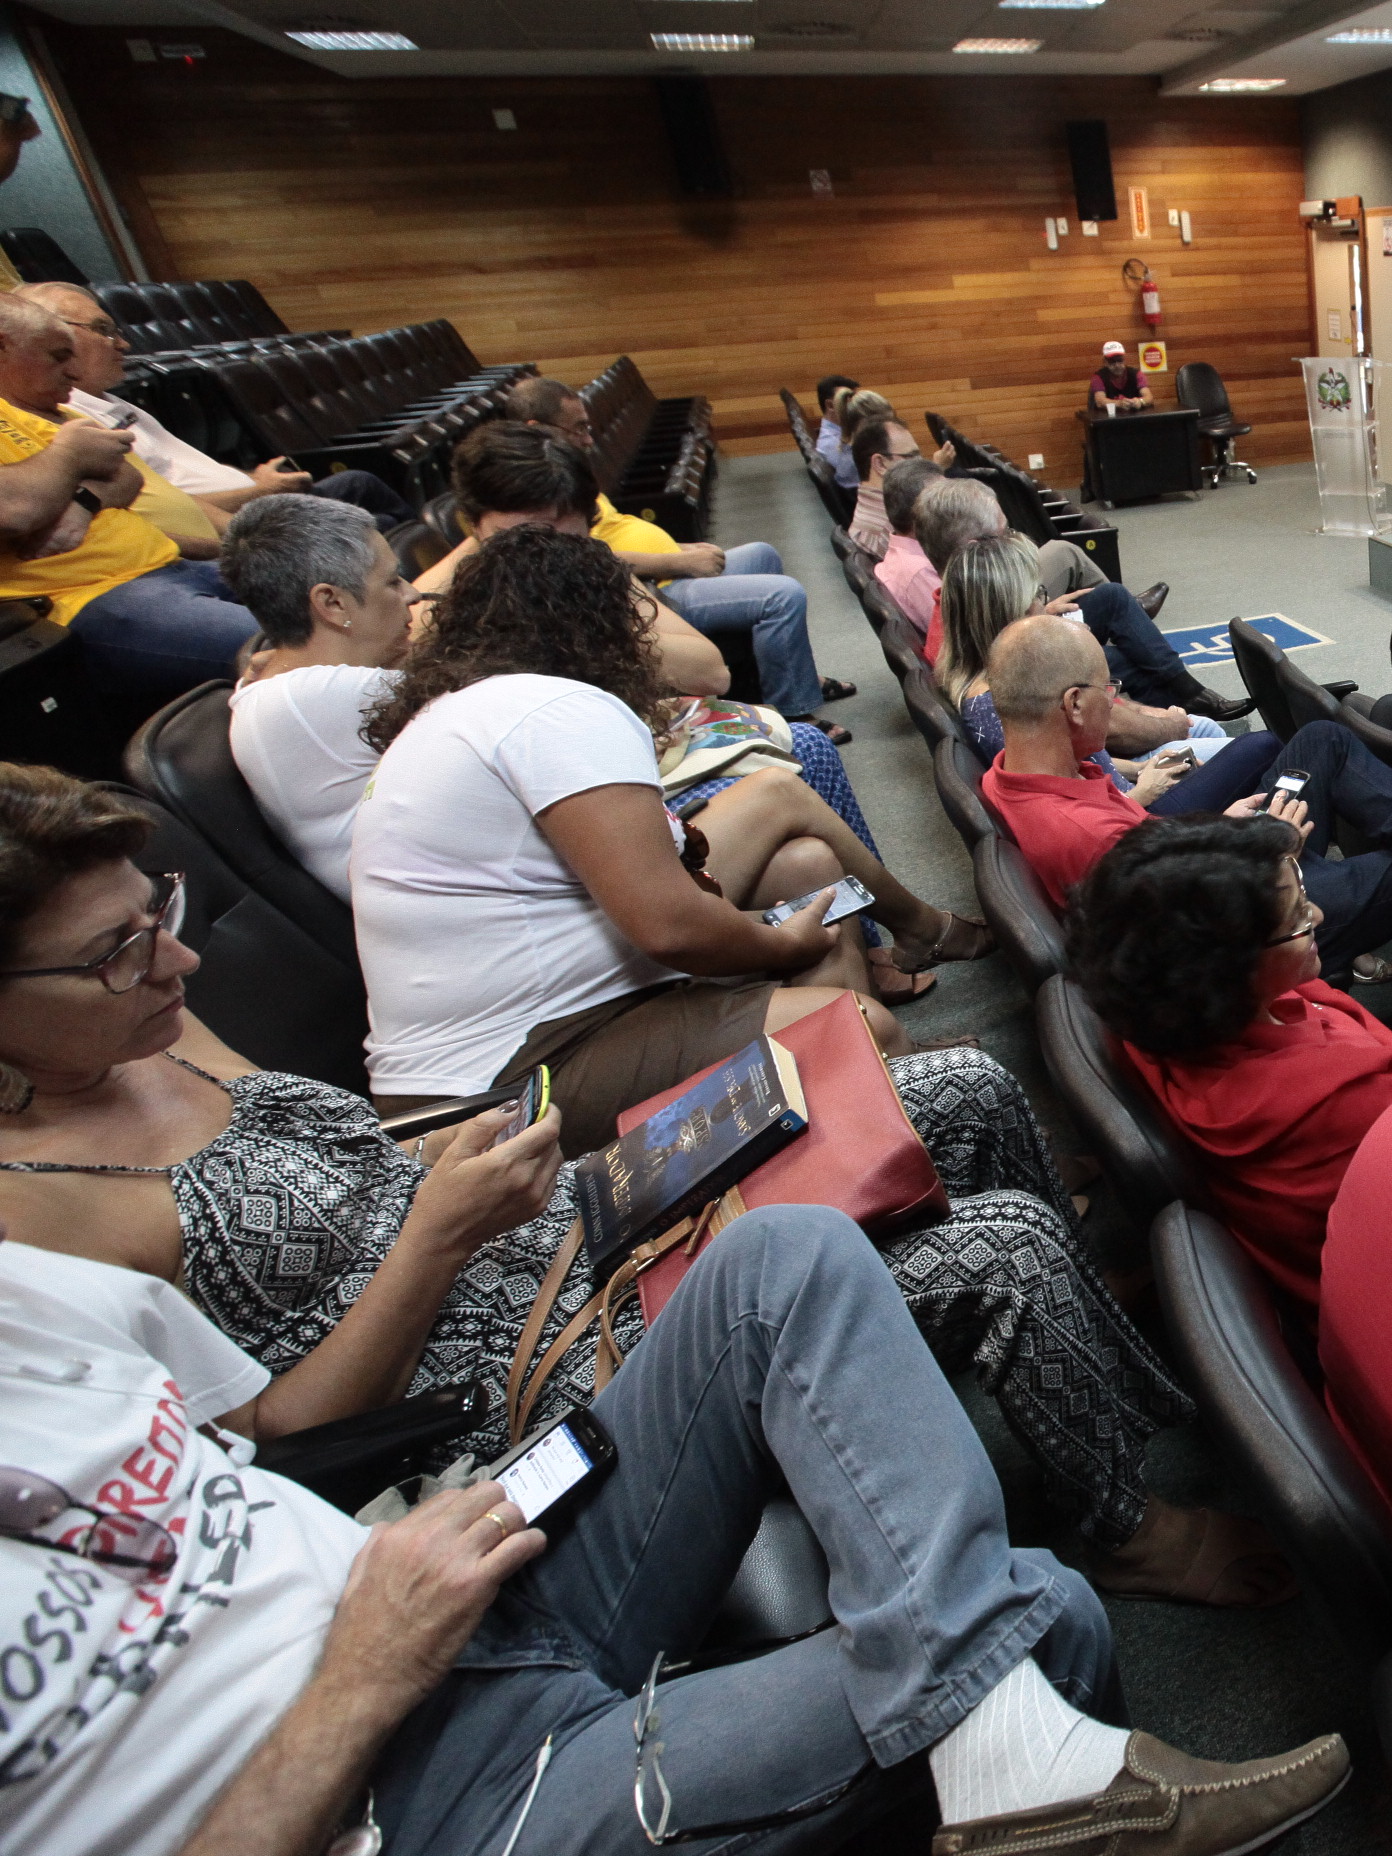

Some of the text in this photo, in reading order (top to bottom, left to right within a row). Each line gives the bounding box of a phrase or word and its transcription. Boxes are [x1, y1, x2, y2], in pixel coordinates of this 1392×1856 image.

[585, 1173, 603, 1243] CONN IGGULDEN
[605, 1142, 634, 1217] IMPERADOR
[60, 1379, 189, 1563] DIREITO
